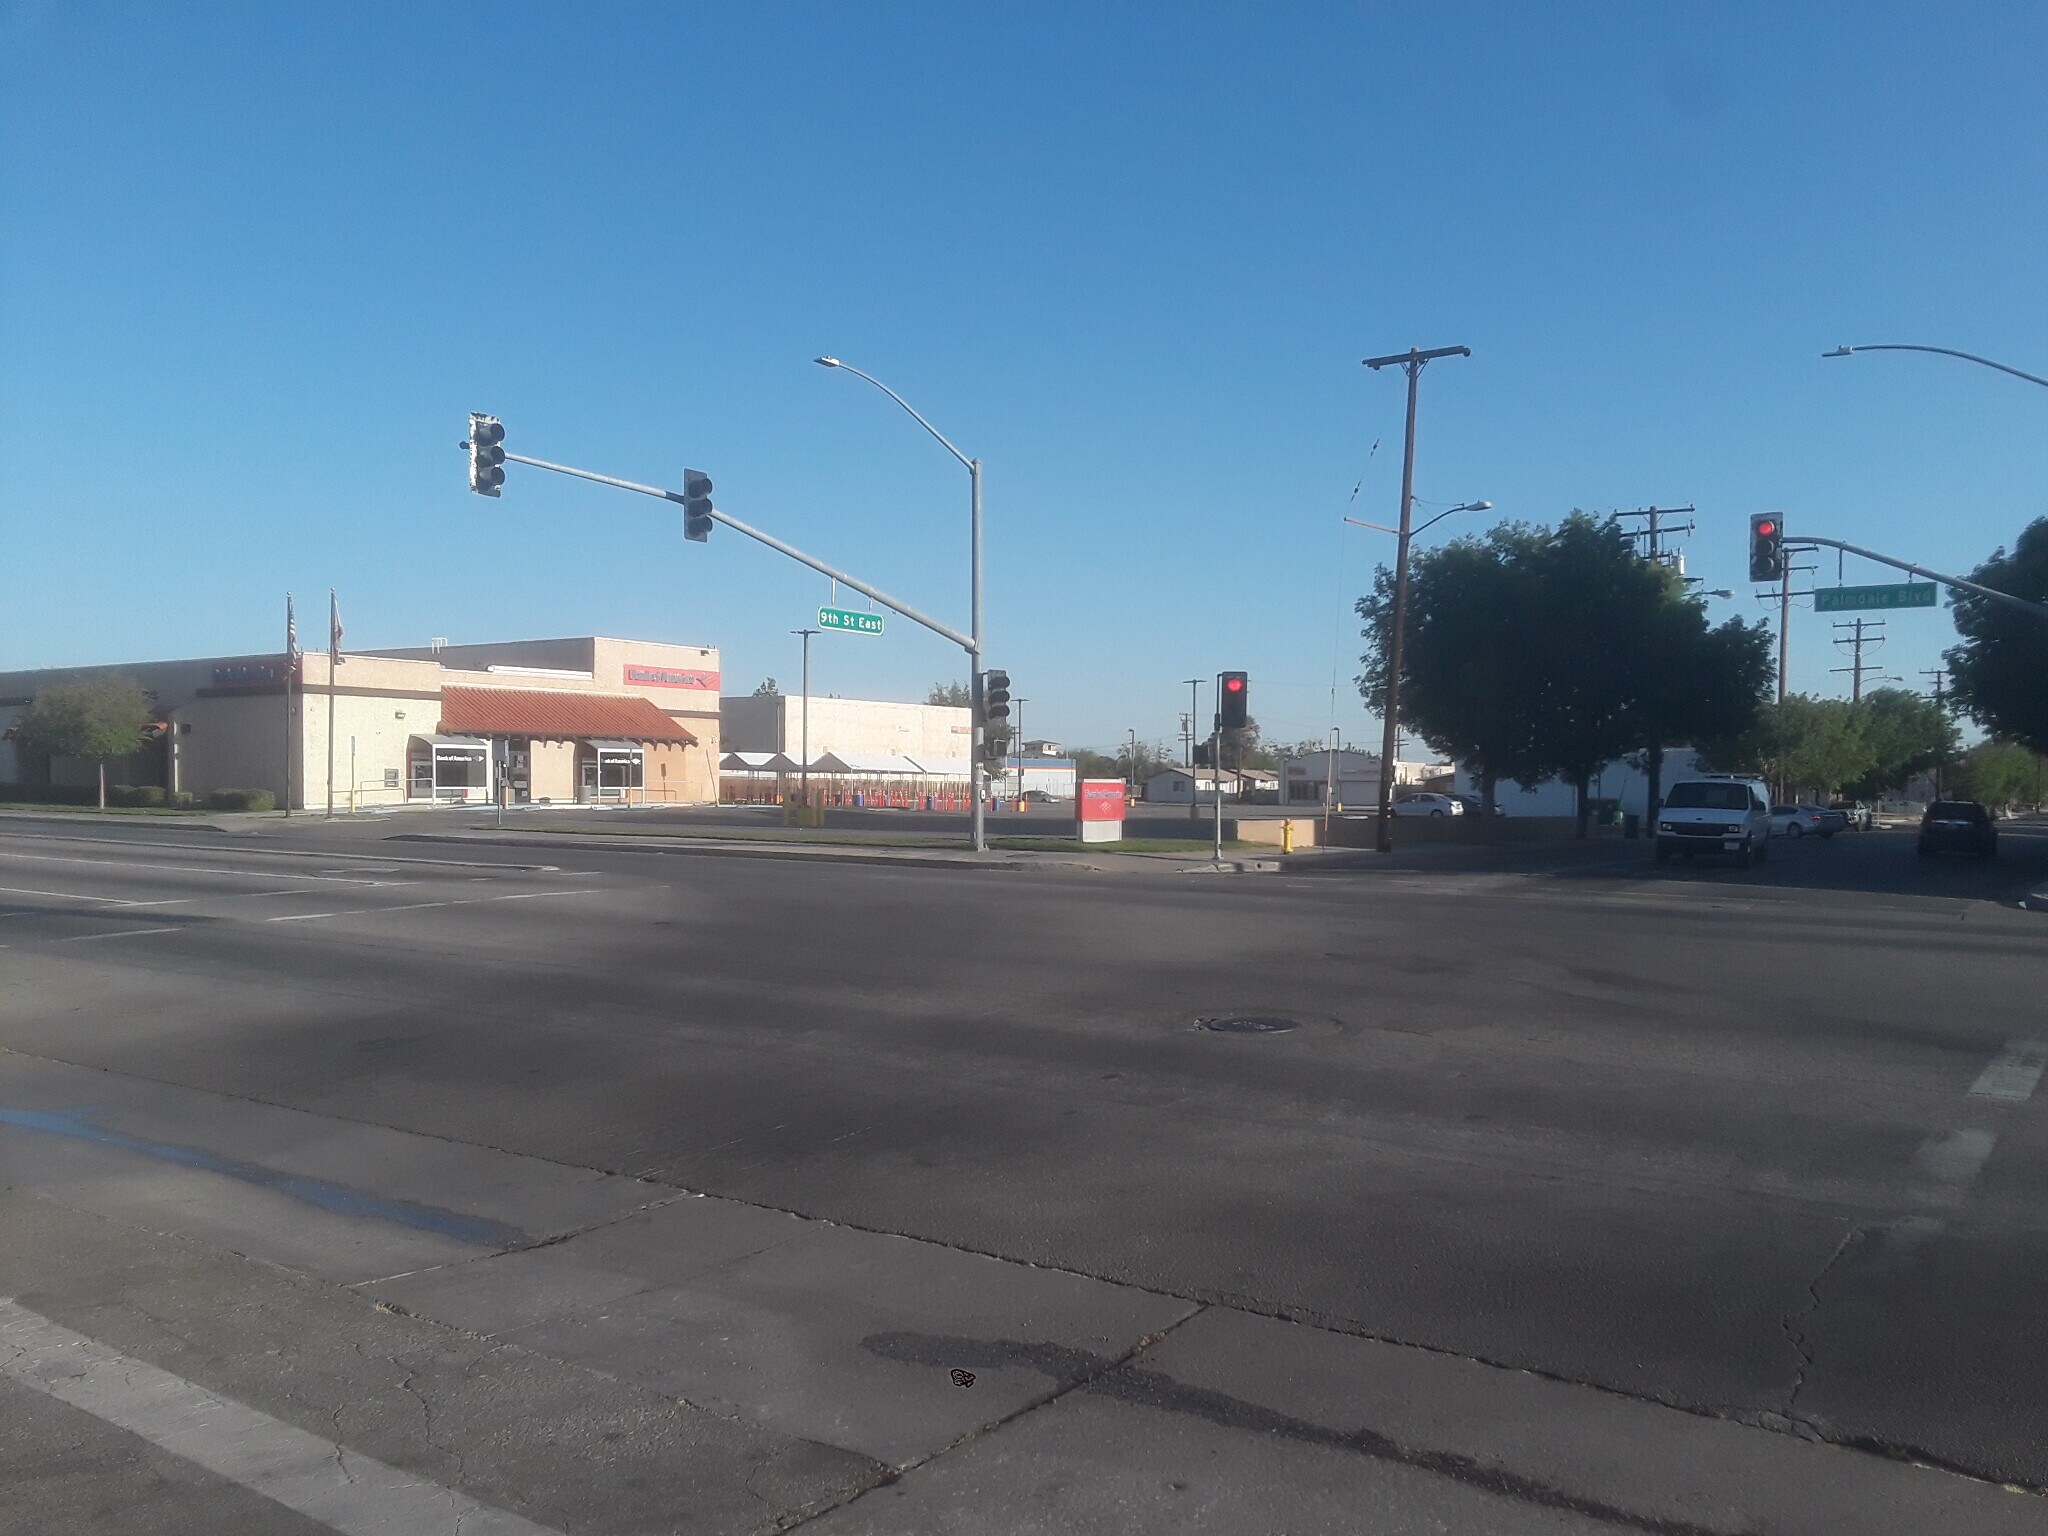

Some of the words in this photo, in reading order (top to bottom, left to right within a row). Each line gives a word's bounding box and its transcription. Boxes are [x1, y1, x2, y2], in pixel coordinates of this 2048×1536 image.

[1821, 592, 1889, 606] Palmdale
[1898, 588, 1931, 602] Blvd
[821, 612, 839, 625] 9th
[843, 614, 855, 627] St
[858, 616, 882, 630] East
